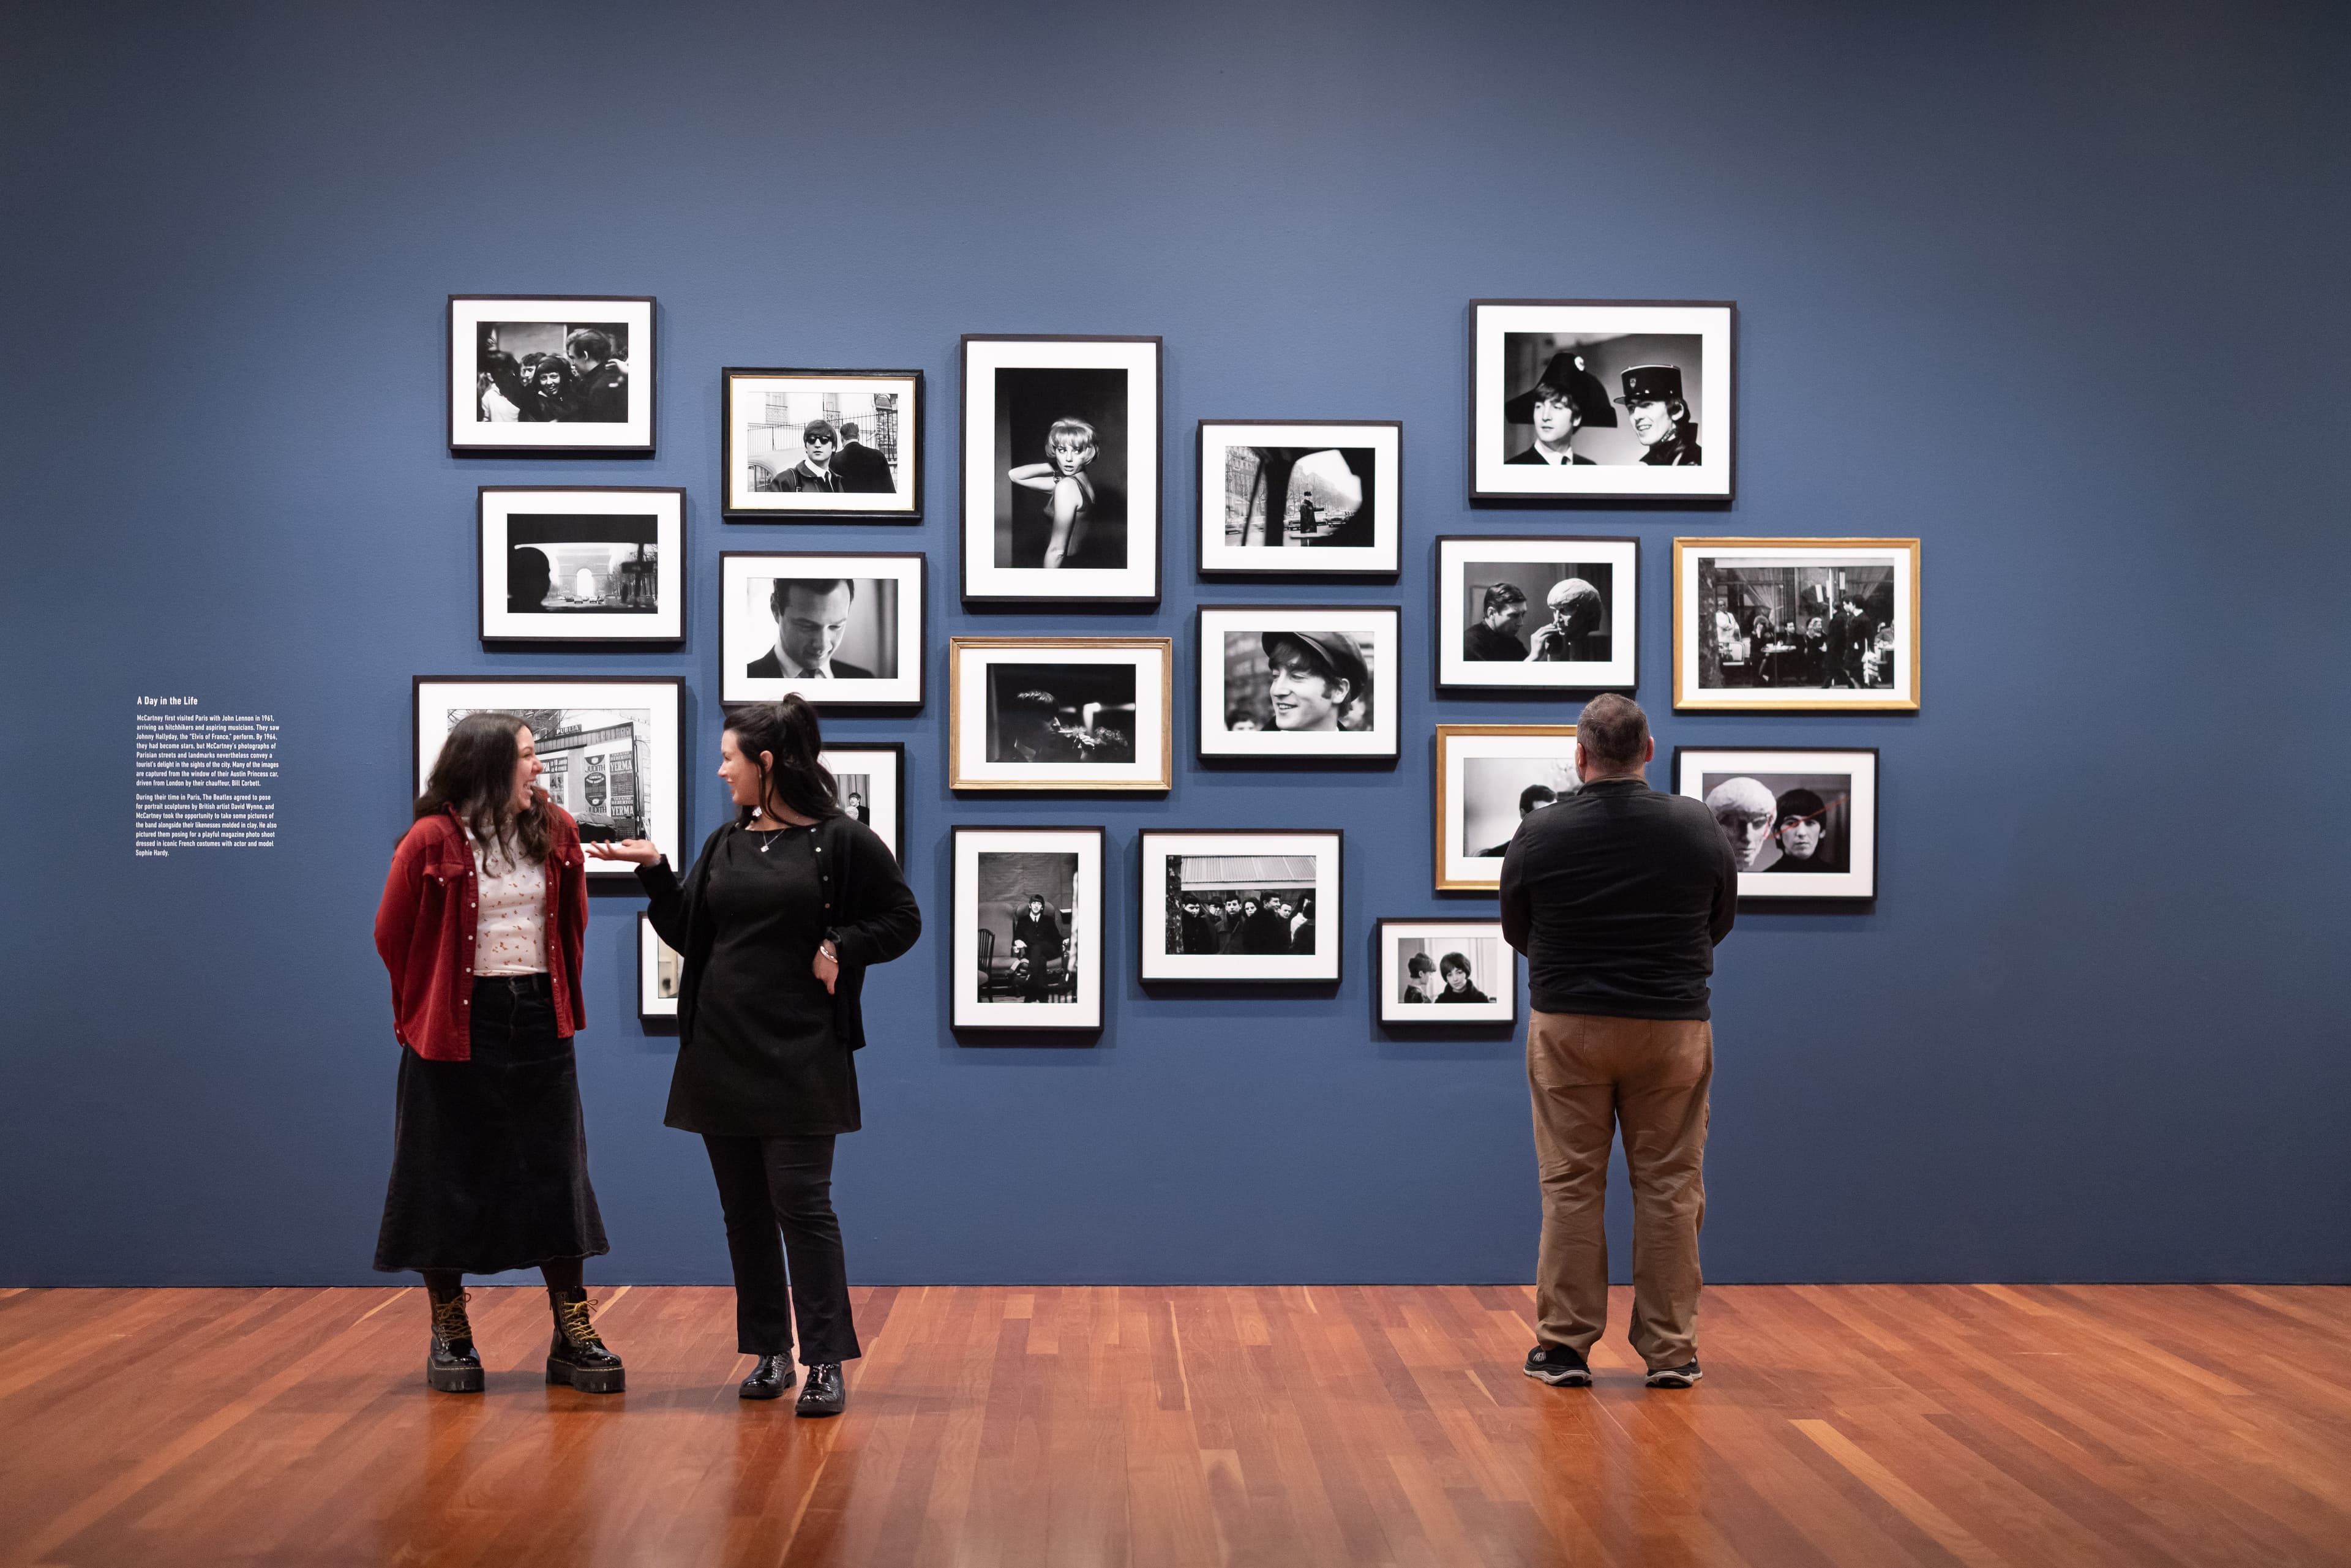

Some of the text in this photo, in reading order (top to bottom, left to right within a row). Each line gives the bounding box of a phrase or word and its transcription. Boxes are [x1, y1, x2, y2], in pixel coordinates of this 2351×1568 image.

[137, 696, 198, 707] A Day in the Life
[206, 724, 227, 732] aspiring
[256, 724, 268, 732] They
[157, 760, 174, 769] delight
[610, 760, 633, 771] YERMA
[233, 793, 251, 802] agreed
[611, 805, 634, 816] YERMA
[184, 812, 213, 820] opportunity
